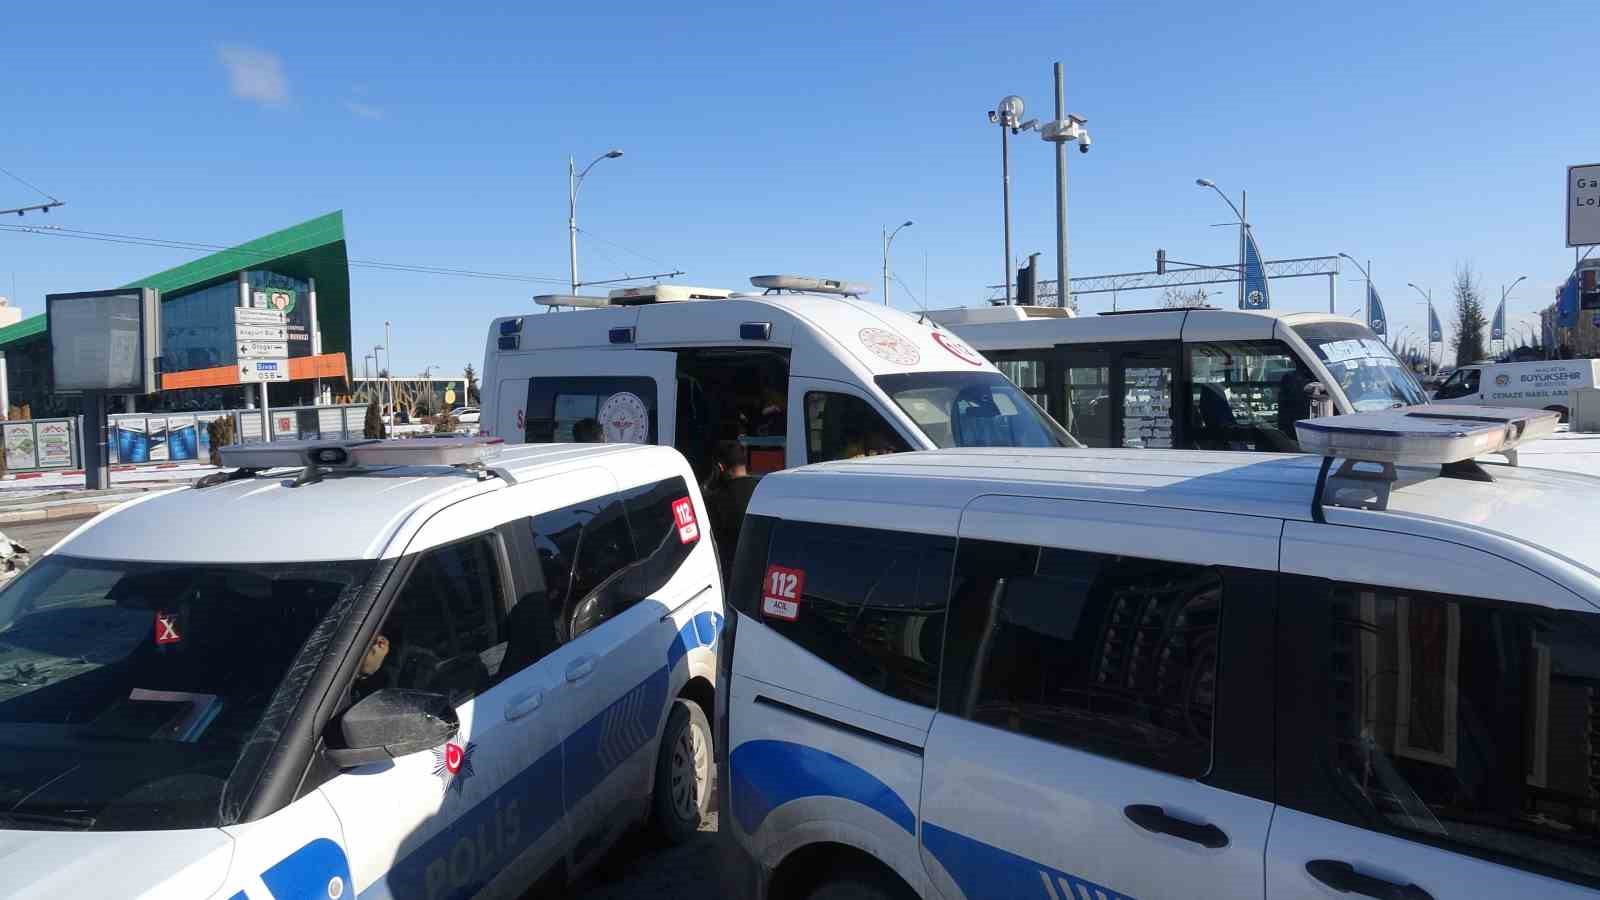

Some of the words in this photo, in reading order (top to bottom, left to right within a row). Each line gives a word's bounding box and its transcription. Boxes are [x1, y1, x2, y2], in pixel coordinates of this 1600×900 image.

[676, 502, 692, 525] 112
[771, 571, 798, 599] 112
[160, 618, 179, 640] X
